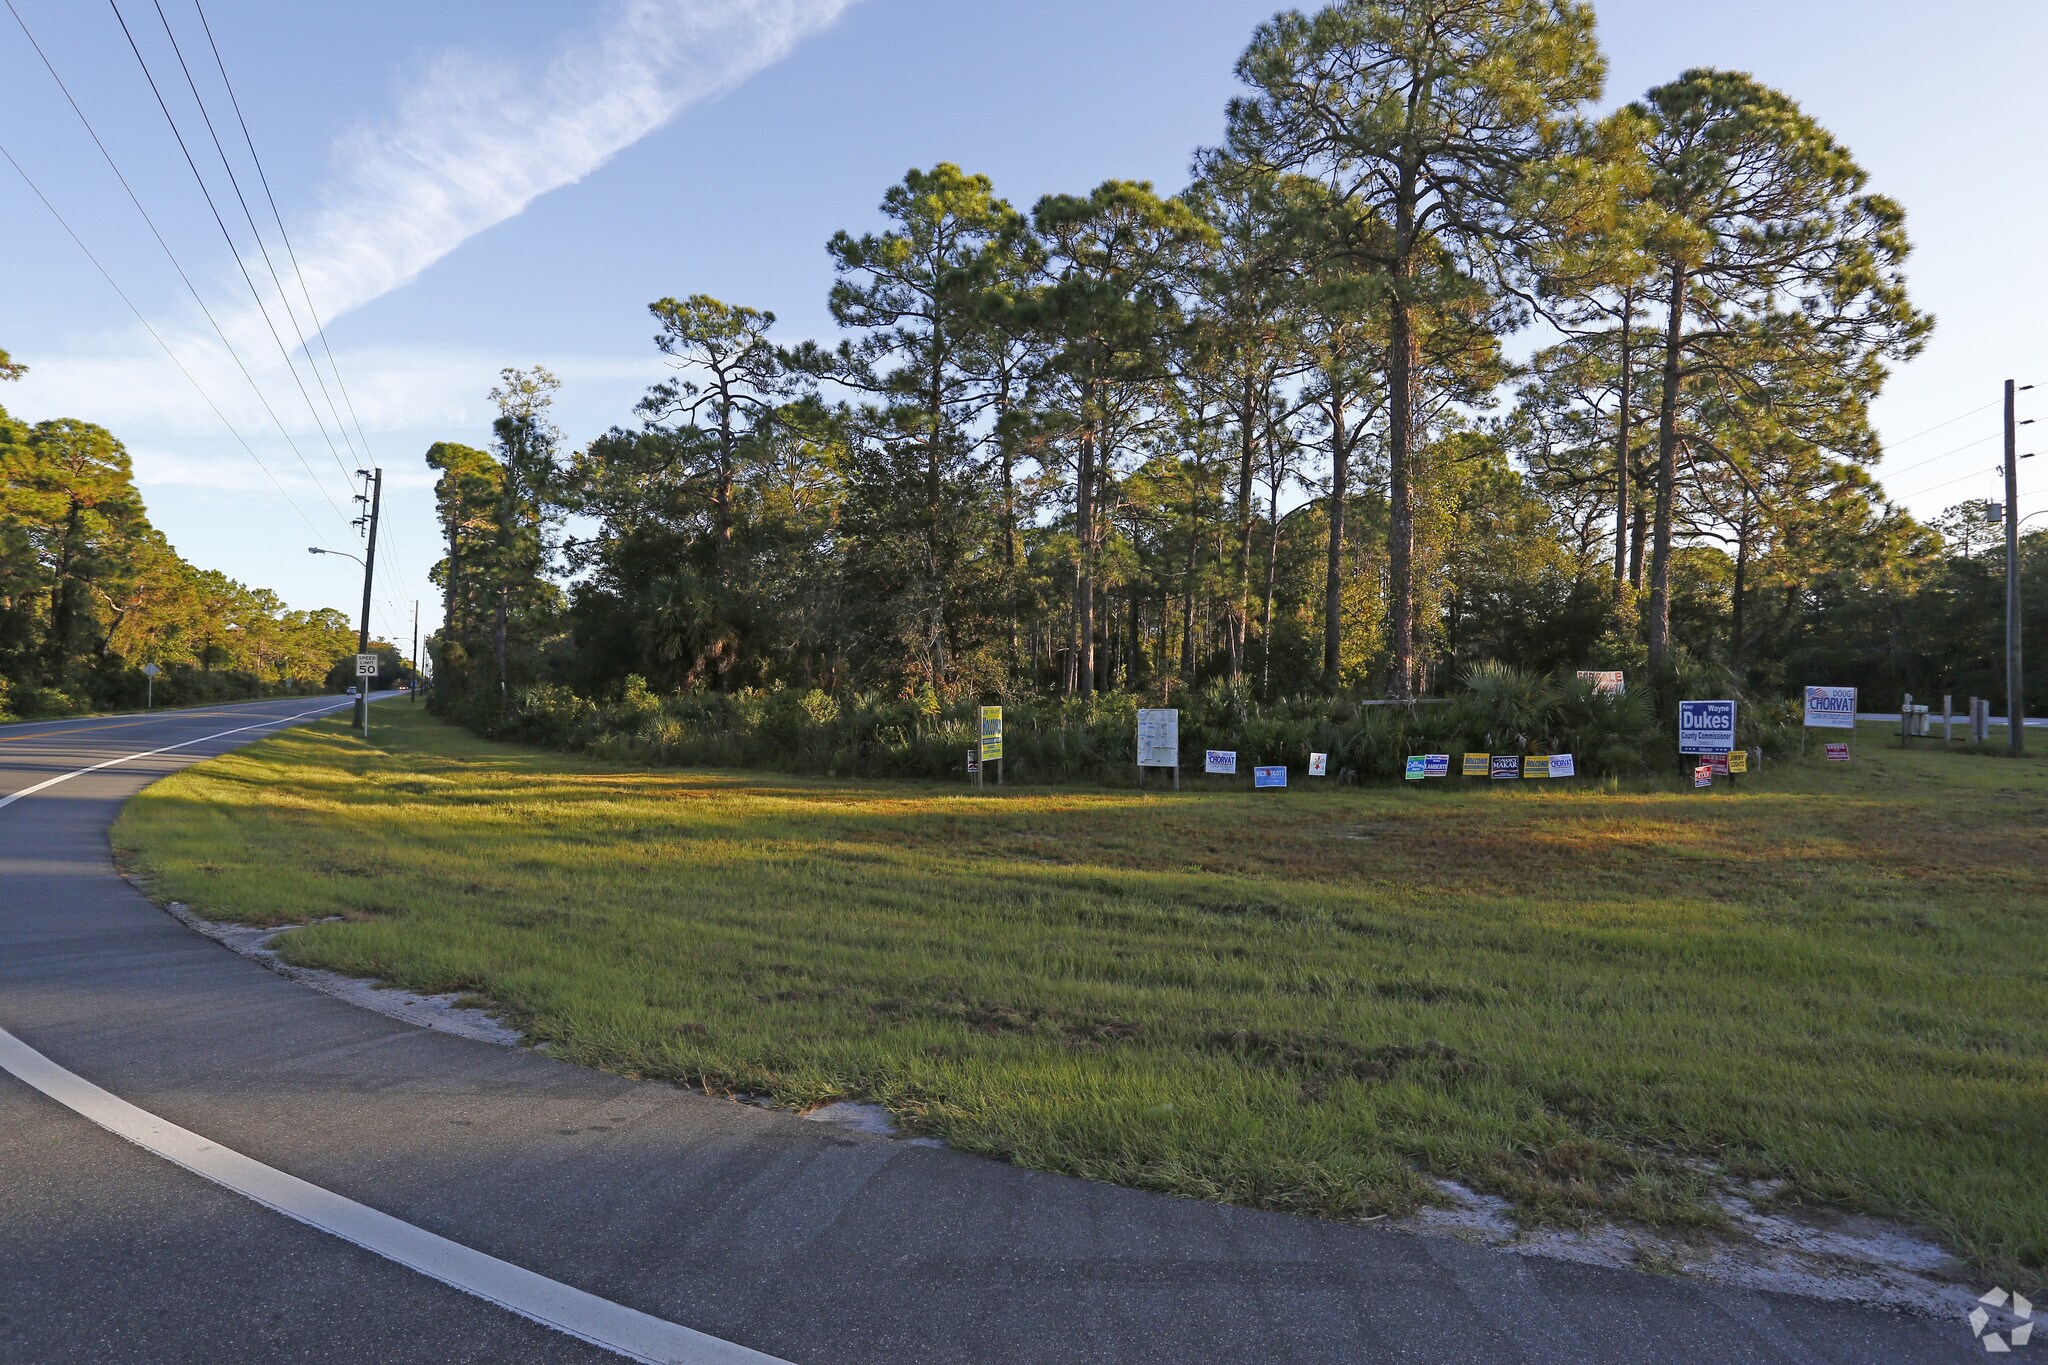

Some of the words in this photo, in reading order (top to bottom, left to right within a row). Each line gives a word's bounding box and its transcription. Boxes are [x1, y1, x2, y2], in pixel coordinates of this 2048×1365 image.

[359, 666, 376, 674] 50
[1833, 690, 1852, 698] DOUG
[1810, 697, 1854, 712] CHORVAT
[1708, 705, 1730, 714] Wayne
[1684, 711, 1730, 729] Dukes
[1682, 732, 1698, 742] County
[1698, 732, 1732, 740] Commissioner
[1210, 756, 1235, 765] CHORVAT
[1465, 757, 1488, 765] HOLCOMB
[1526, 760, 1549, 768] HOLCOMB
